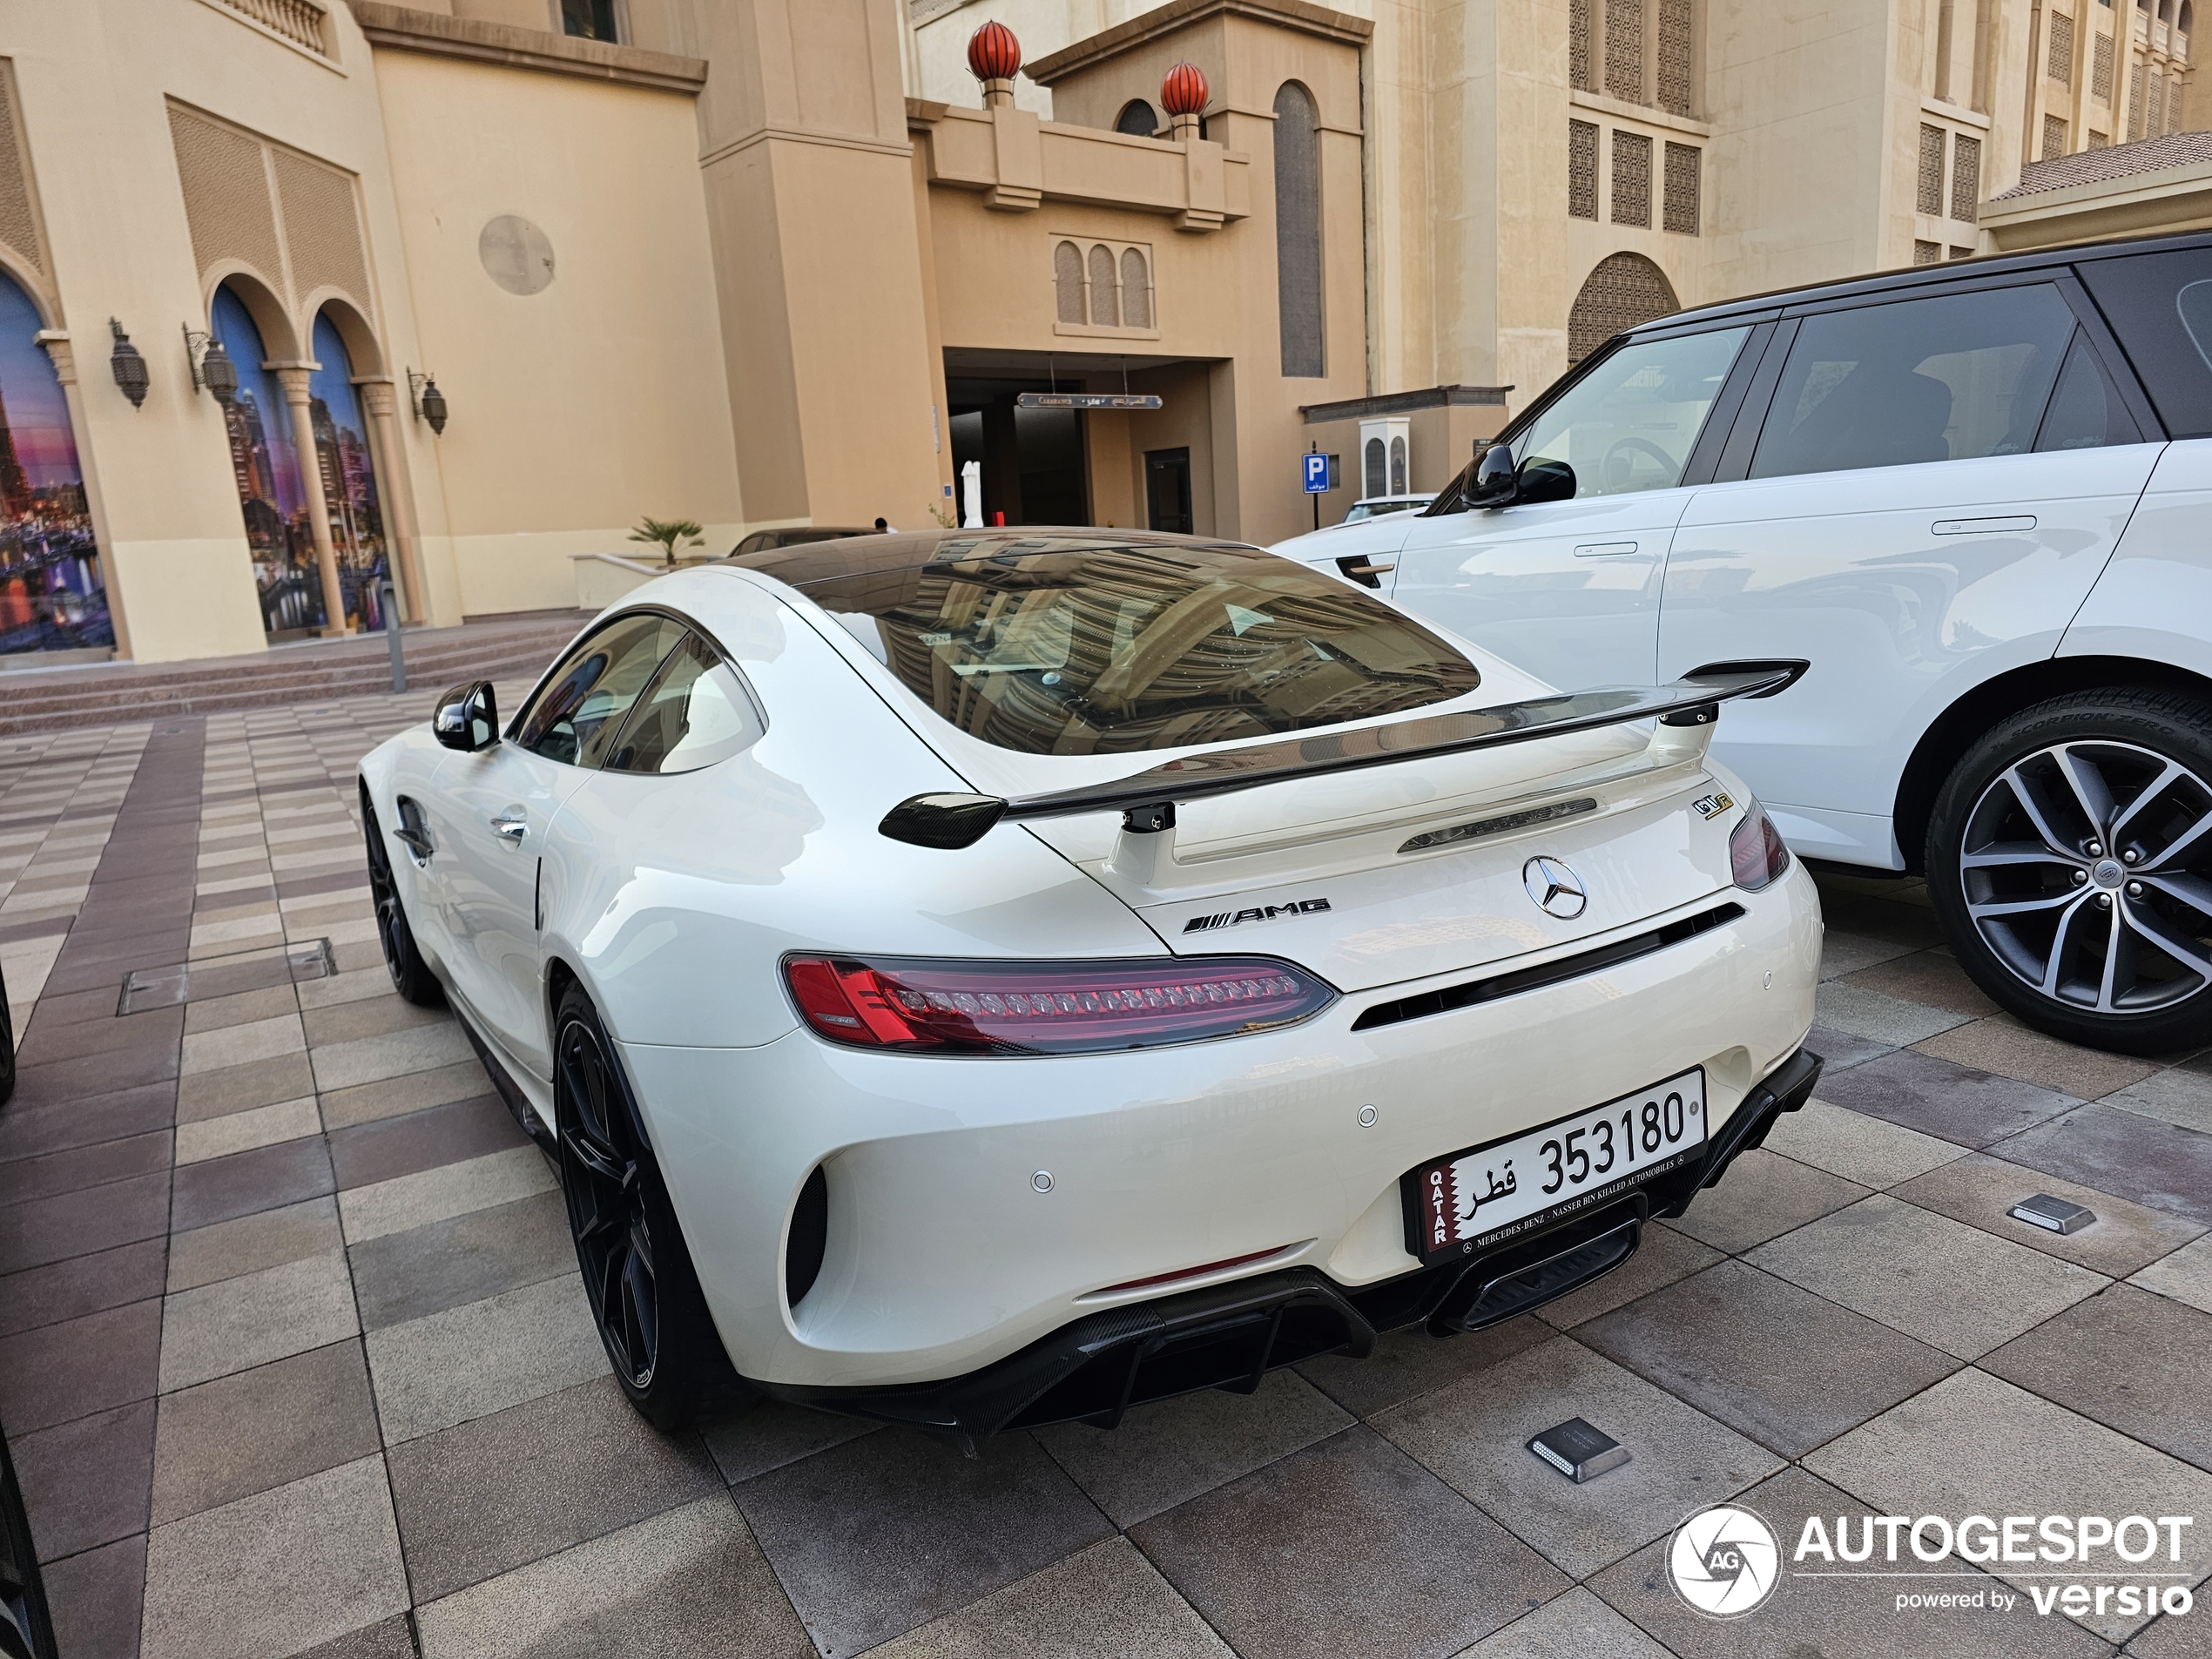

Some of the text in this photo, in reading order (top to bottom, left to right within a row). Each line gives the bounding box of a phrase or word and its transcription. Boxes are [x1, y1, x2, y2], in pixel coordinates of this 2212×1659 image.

[1309, 458, 1324, 481] P
[2011, 712, 2174, 738] SCORPION ZERO
[1538, 1091, 1684, 1195] 353180
[1430, 1171, 1447, 1245] QATAR
[1460, 1159, 1517, 1220] قطر
[1476, 1214, 1545, 1249] MERCEDES-BENZ
[1552, 1199, 1581, 1219] NASSER
[1582, 1192, 1595, 1206] BIN
[1597, 1181, 1626, 1199] KHALED
[1627, 1159, 1675, 1186] AUTOMOBILES
